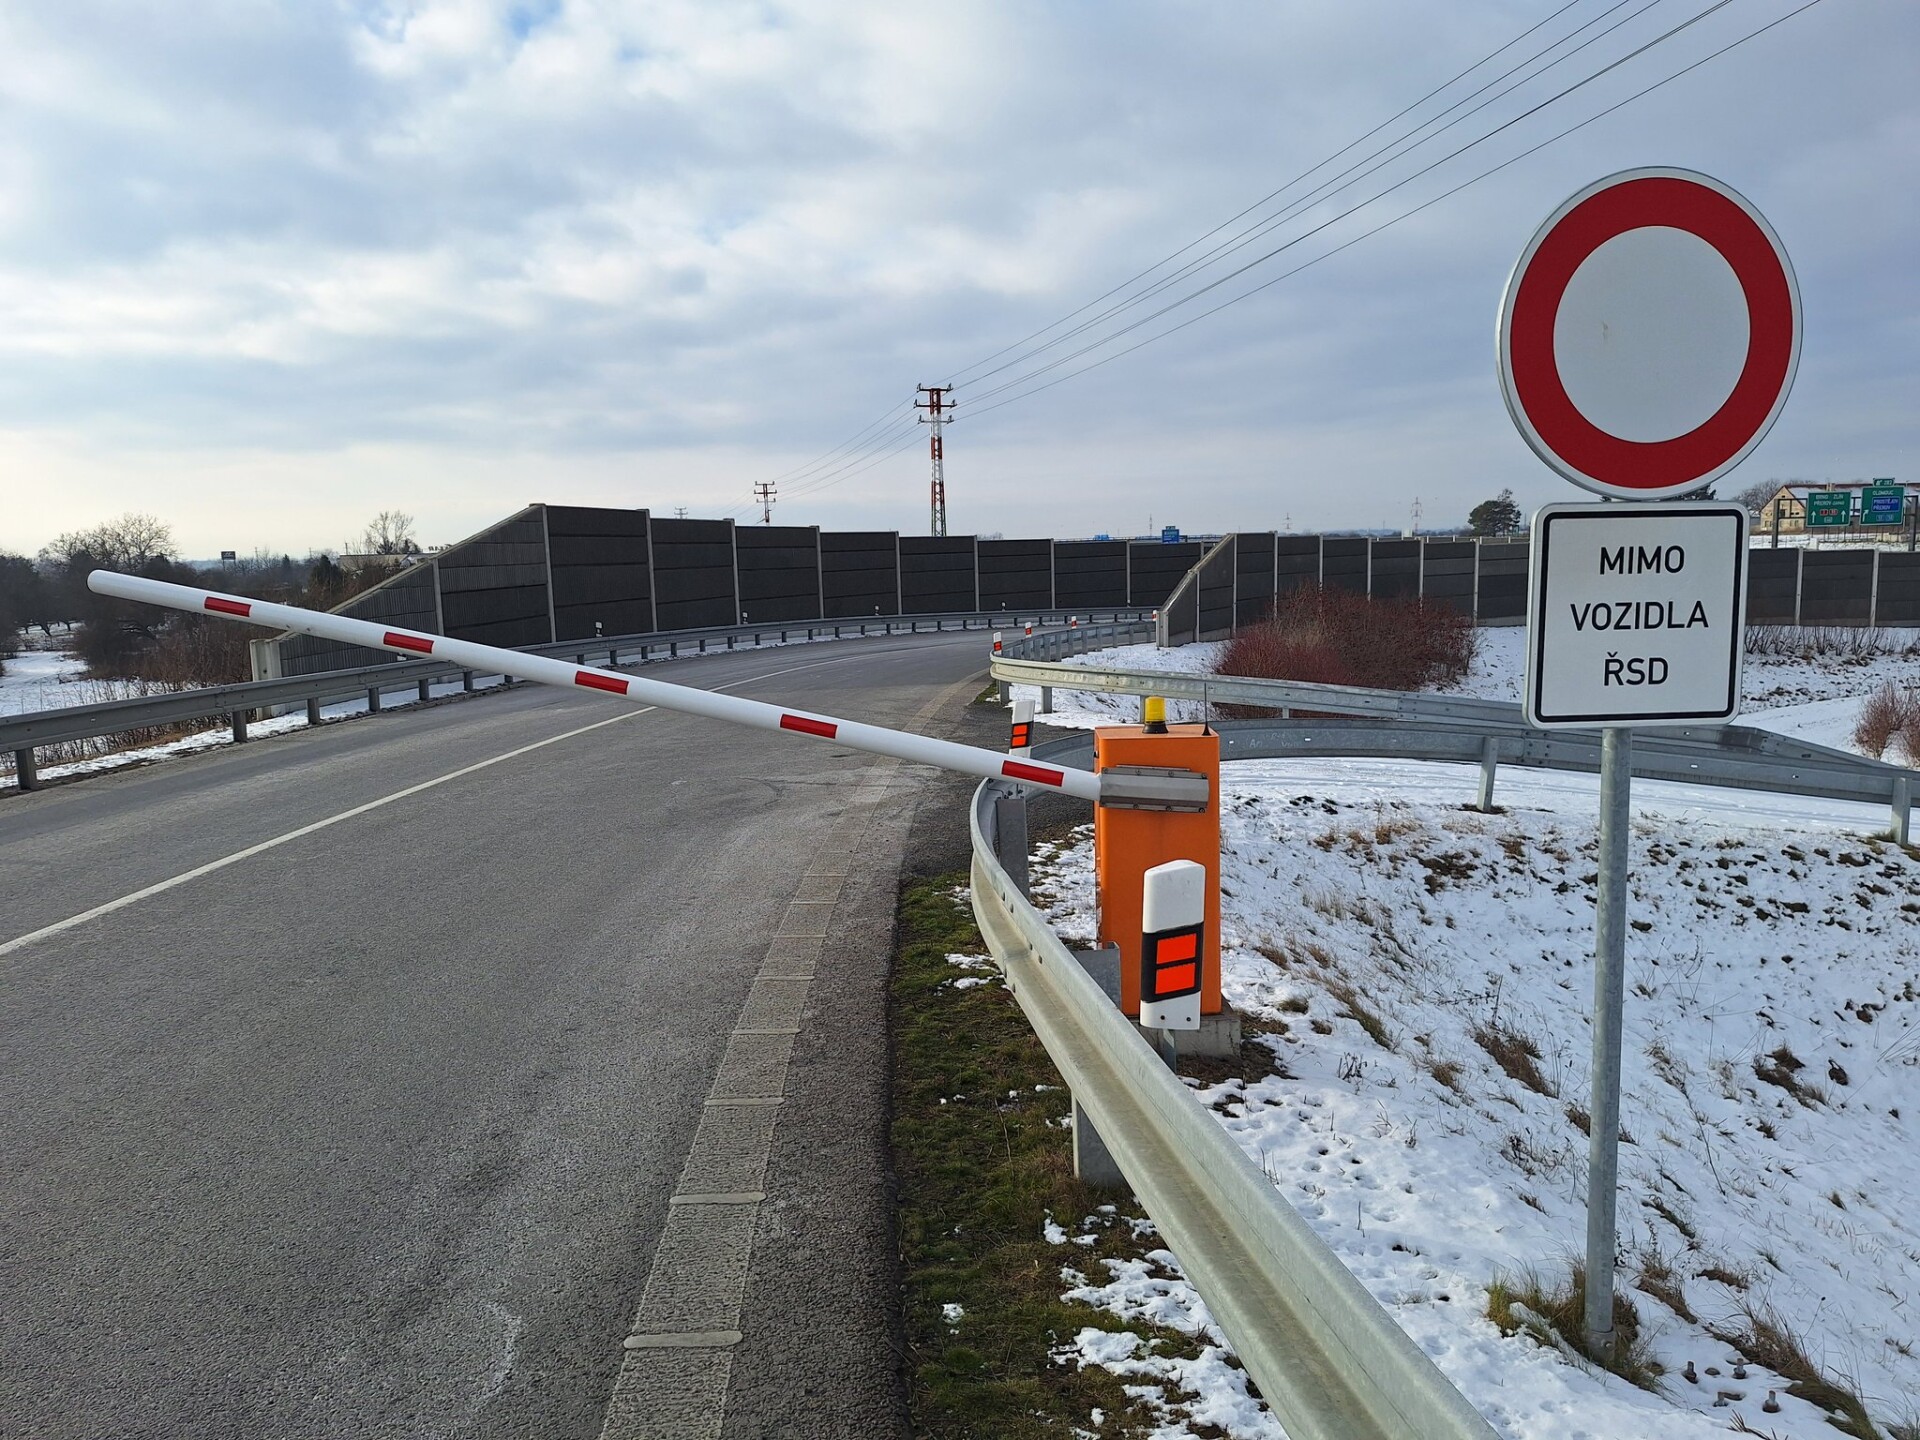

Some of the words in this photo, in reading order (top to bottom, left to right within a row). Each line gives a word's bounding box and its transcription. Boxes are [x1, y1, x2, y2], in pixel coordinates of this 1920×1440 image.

[1599, 545, 1685, 575] MIMO
[1570, 600, 1709, 631] VOZIDLA
[1603, 651, 1669, 686] ŘSD
